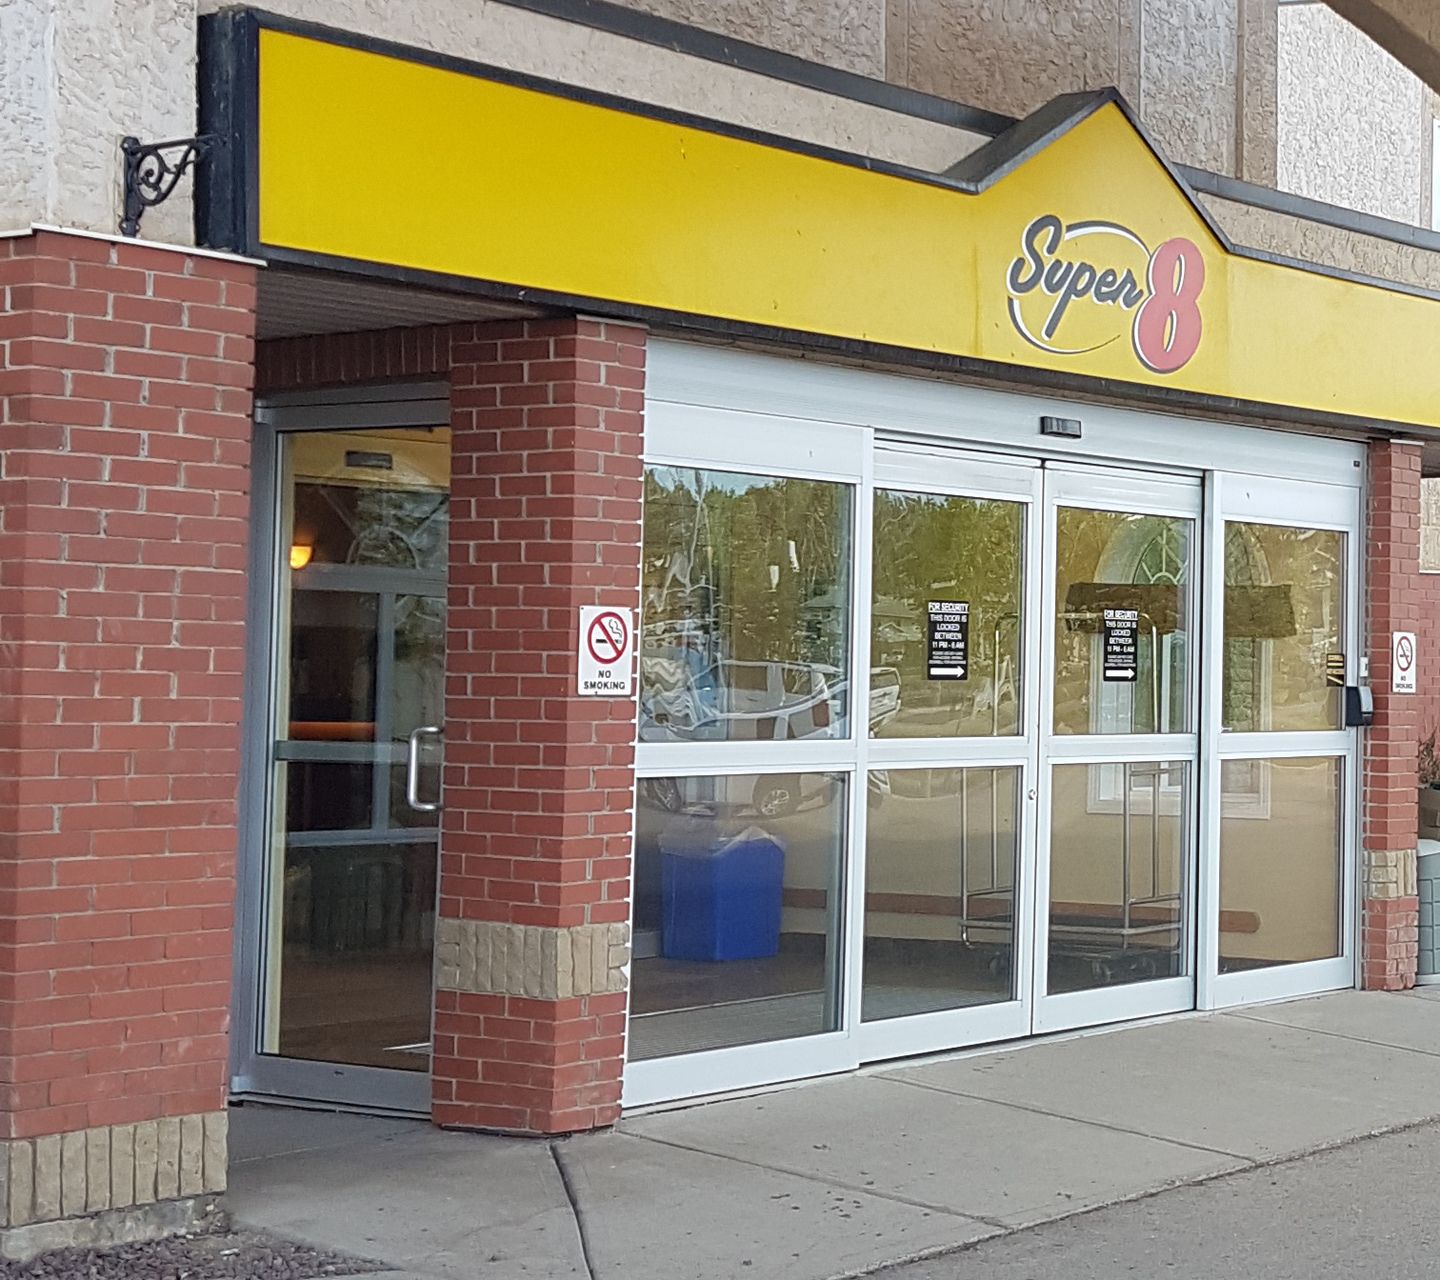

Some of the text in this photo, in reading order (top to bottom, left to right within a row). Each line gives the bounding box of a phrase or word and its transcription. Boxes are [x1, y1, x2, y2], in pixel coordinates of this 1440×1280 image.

[1007, 214, 1205, 374] Super 8
[928, 602, 969, 613] FOR SECURITY
[944, 614, 960, 622] DOOR
[937, 623, 960, 631] LOCKED
[598, 670, 612, 678] NO
[583, 681, 626, 690] SMOKING
